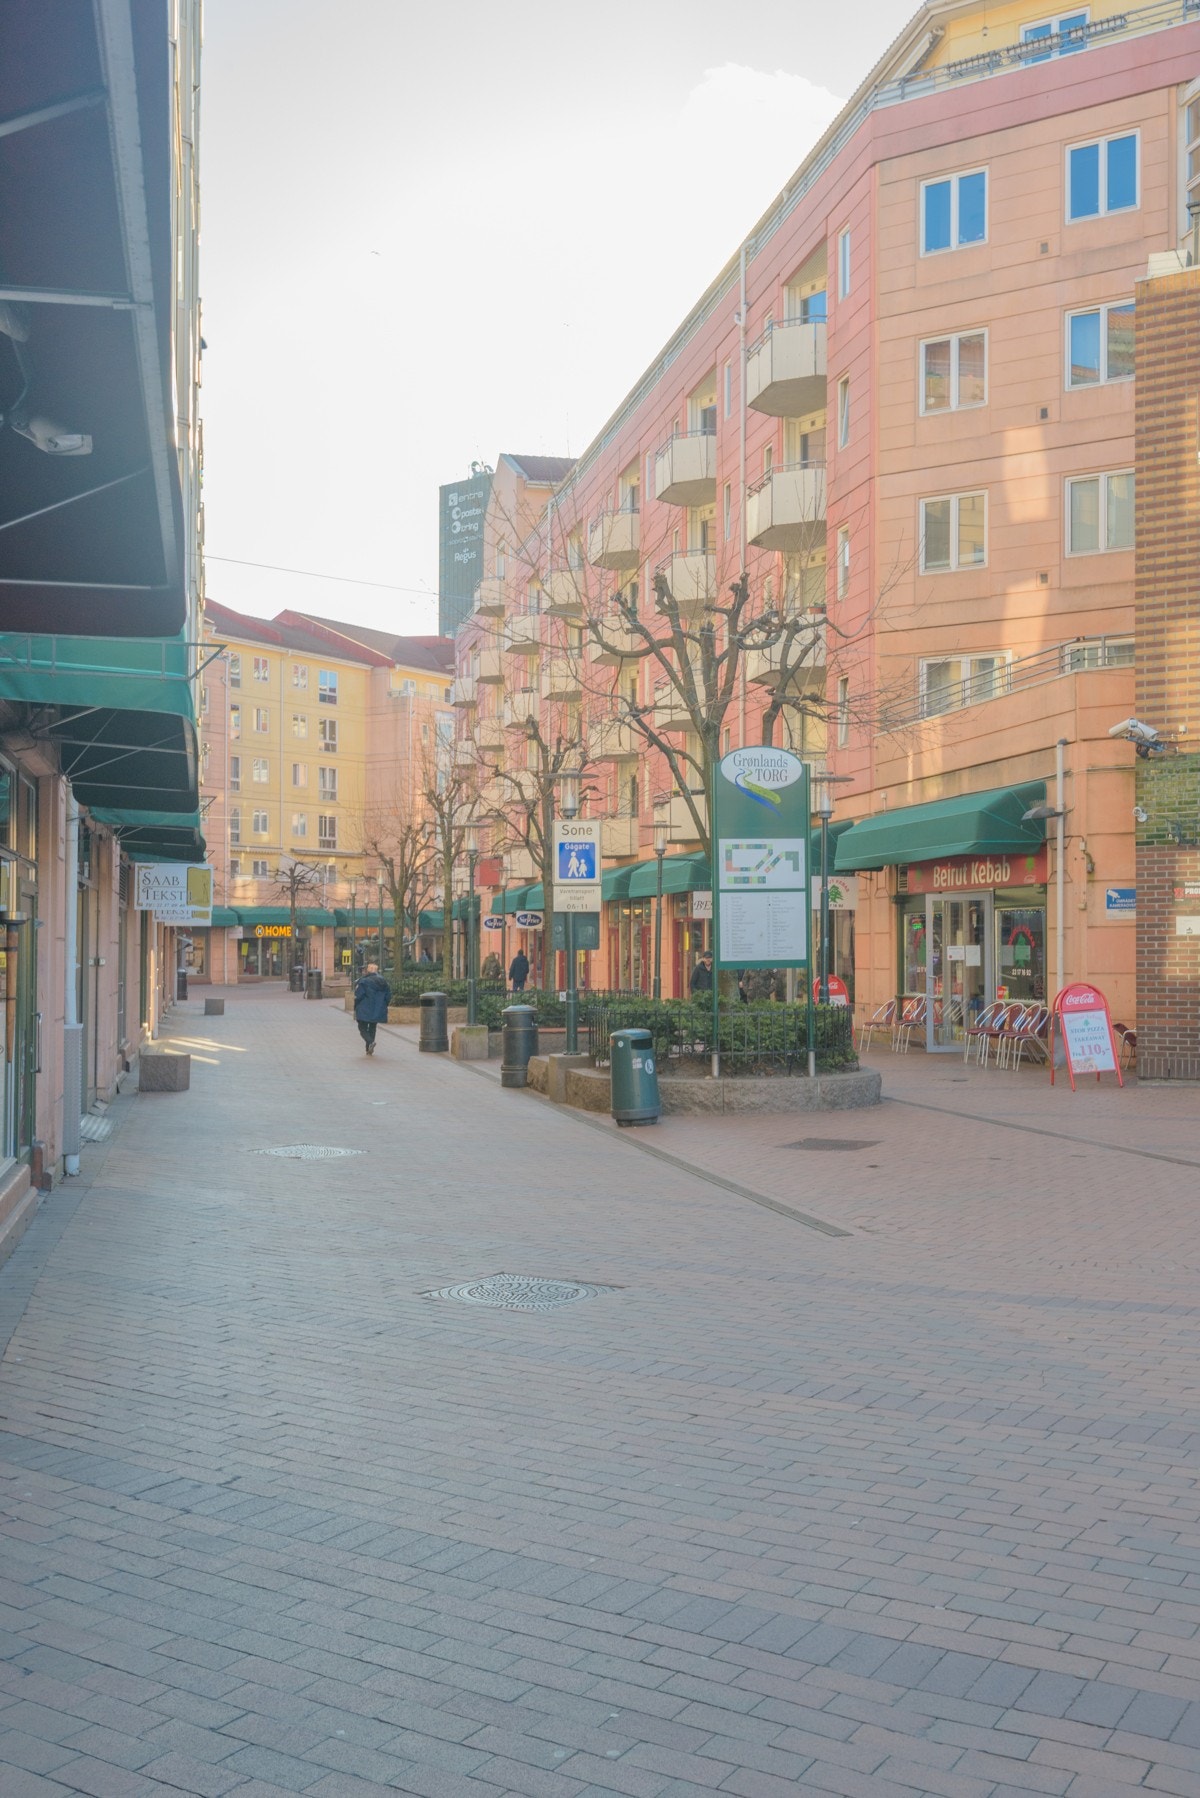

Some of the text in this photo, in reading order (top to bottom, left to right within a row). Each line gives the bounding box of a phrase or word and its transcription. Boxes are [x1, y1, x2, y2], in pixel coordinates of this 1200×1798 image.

[454, 552, 476, 563] Regus
[733, 754, 788, 767] Grønlands
[755, 769, 788, 782] TORG
[561, 824, 592, 836] Sone
[565, 842, 589, 851] Gågate
[933, 855, 1010, 887] Beirut Kebab
[265, 926, 292, 937] HOME
